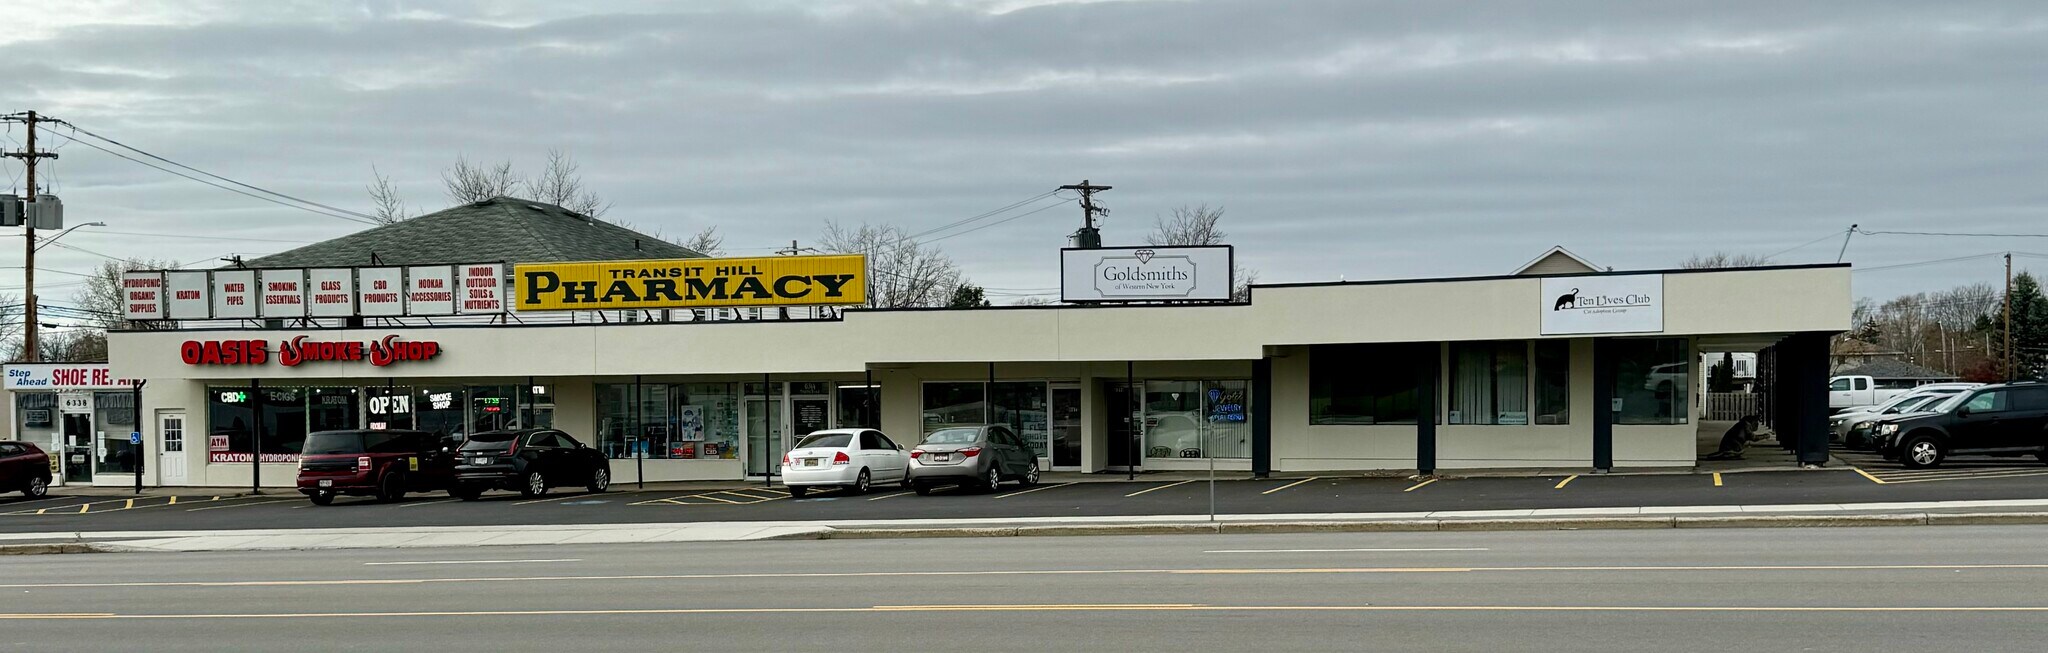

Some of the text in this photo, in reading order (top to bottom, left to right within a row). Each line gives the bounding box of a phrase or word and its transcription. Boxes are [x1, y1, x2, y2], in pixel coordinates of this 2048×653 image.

[468, 266, 493, 277] INDOOR
[608, 264, 763, 279] TRANSIT HILL
[1104, 266, 1188, 281] Goldsmiths
[124, 278, 161, 288] HYDROPONIC
[224, 283, 245, 293] WATER
[268, 281, 297, 292] SMOKING
[321, 280, 341, 291] GLASS
[373, 280, 387, 290] CBD
[418, 278, 443, 289] HOOKAH
[465, 278, 497, 288] OUTDOOR
[524, 270, 855, 305] PHARMACY
[129, 291, 156, 301] ORGANIC
[176, 290, 200, 300] KRATOM
[265, 294, 301, 305] ESSENTIALS
[315, 293, 349, 304] PRODUCTS
[364, 292, 398, 303] PRODUCTS
[411, 291, 452, 302] ACCESSORIES
[469, 289, 494, 299] SOILS &
[226, 296, 244, 306] PIPES
[464, 299, 500, 310] NUTRIENTS
[1577, 296, 1594, 307] Ten
[1626, 294, 1651, 305] Club
[129, 303, 157, 314] SUPPLIES
[181, 334, 441, 367] OASIS SMOKE SHOP
[9, 369, 31, 379] Step
[52, 368, 88, 386] SHOE
[16, 378, 47, 386] Ahead
[429, 393, 452, 402] SMOKE
[369, 395, 410, 415] OPEN
[432, 401, 450, 410] SHOP
[211, 438, 227, 447] ATM
[212, 453, 254, 463] KRATOM
